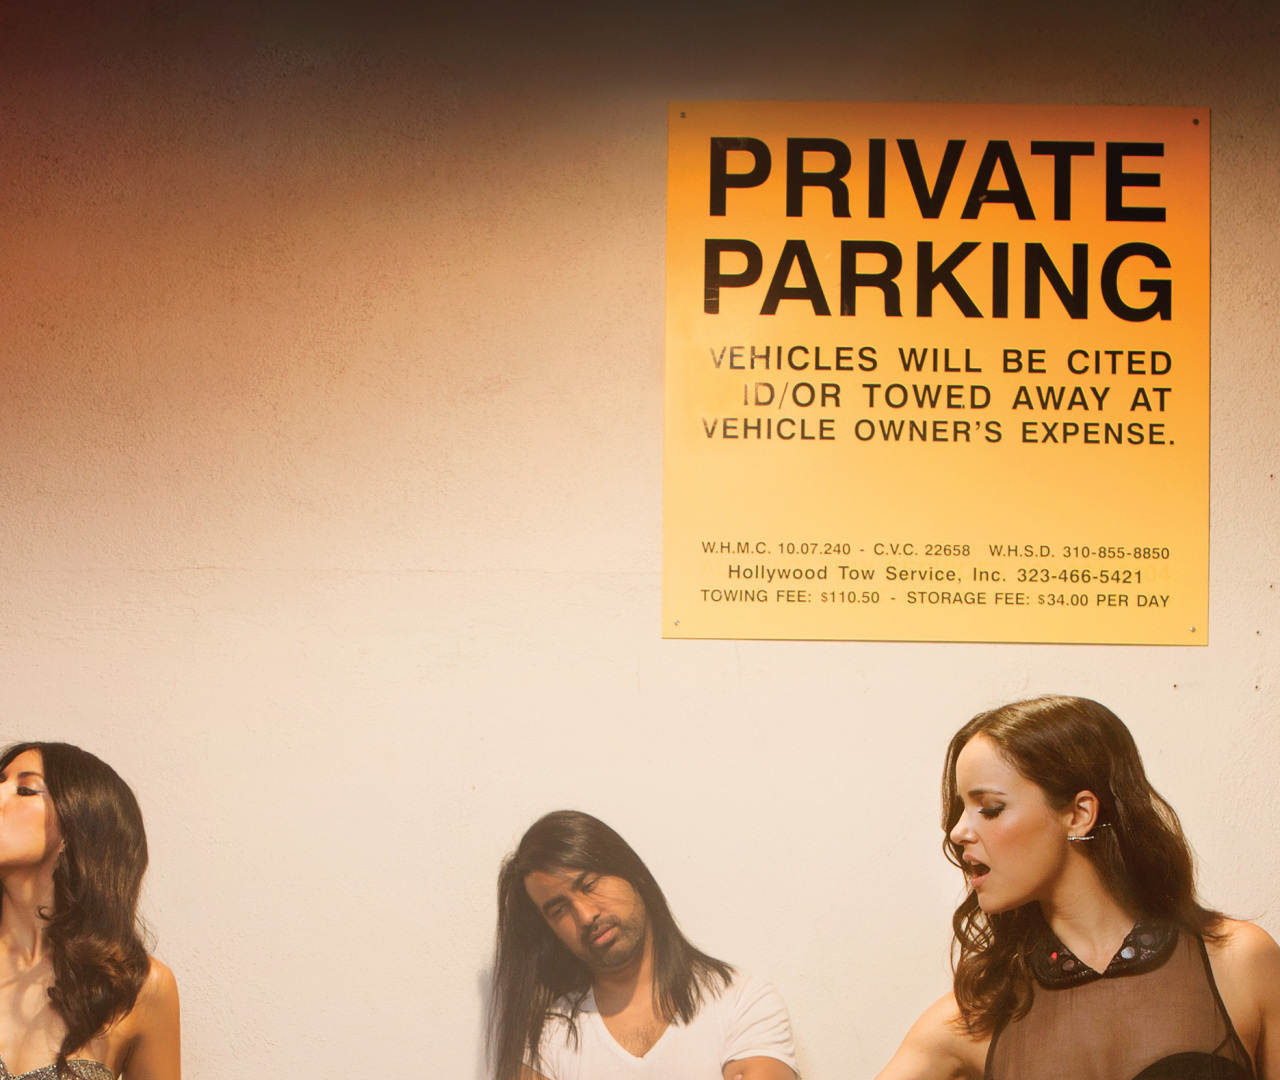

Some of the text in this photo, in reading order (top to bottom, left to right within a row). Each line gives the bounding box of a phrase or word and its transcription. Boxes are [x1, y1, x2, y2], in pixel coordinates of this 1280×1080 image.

[709, 136, 1167, 223] PRIVATE
[703, 238, 1173, 323] PARKING
[710, 345, 1173, 376] VEHICLES WILL BE CITED
[862, 383, 992, 410] TOWED
[1012, 385, 1111, 412] AWAY
[1130, 386, 1173, 413] AT
[701, 417, 1175, 446] VEHICLE OWNER'S EXPENSE.
[701, 541, 771, 555] W.H.M.C.
[778, 542, 851, 556] 10.07.240
[873, 543, 918, 556] C.V.C.
[924, 543, 971, 557] 22658
[988, 544, 1056, 558] W.H.S.D.
[1062, 546, 1170, 560] 310-855-8850
[728, 564, 1142, 584] Hollywood Tow Service, Inc. 323-466-5421
[700, 589, 768, 603] TOWING
[776, 589, 812, 603] FEE:
[821, 591, 880, 604] $110.50
[907, 591, 987, 605] STORAGE
[995, 592, 1030, 606] FEE:
[1037, 593, 1089, 607] $34.00
[1096, 593, 1129, 607] PER
[1136, 594, 1170, 608] DAY
